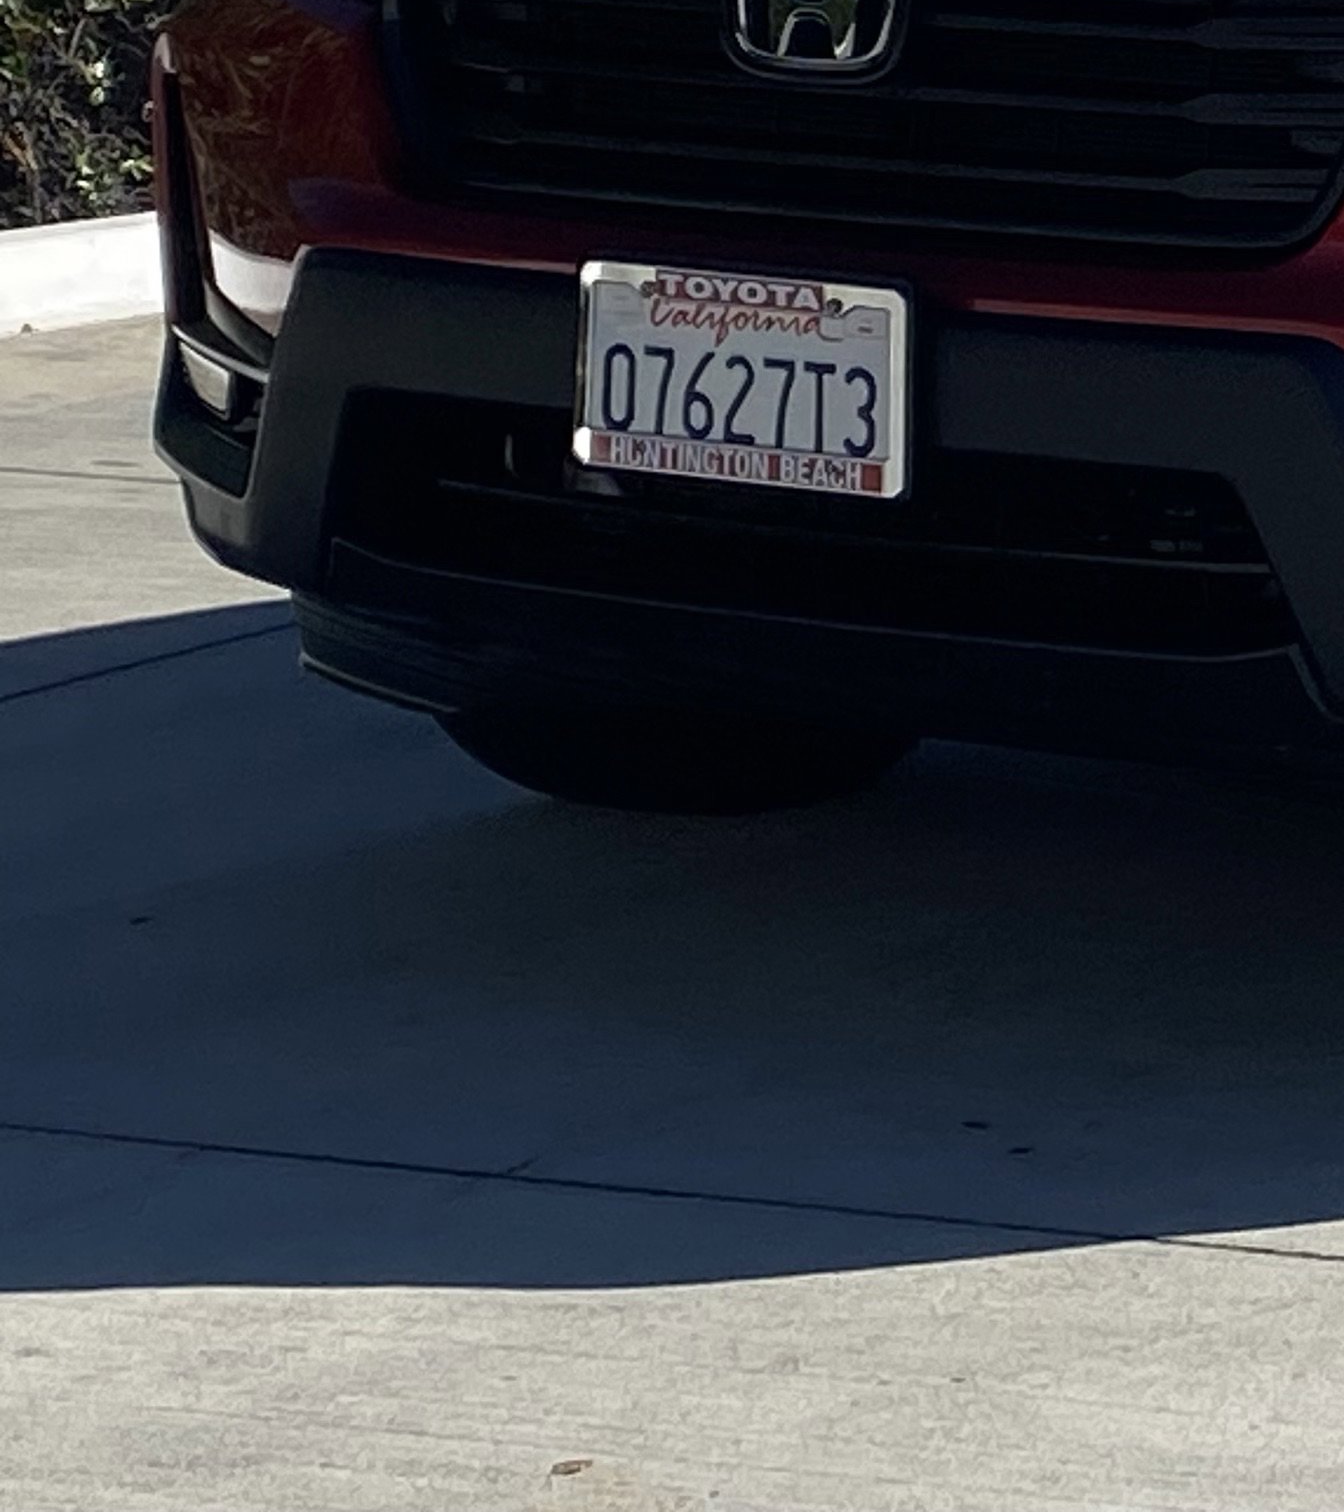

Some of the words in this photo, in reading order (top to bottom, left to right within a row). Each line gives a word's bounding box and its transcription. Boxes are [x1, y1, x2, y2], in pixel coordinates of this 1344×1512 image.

[656, 273, 821, 311] TOYOTA
[650, 297, 823, 347] California
[602, 343, 878, 458] 07627T3
[610, 436, 768, 478] HUNTINGTON
[780, 460, 862, 491] BEACH
